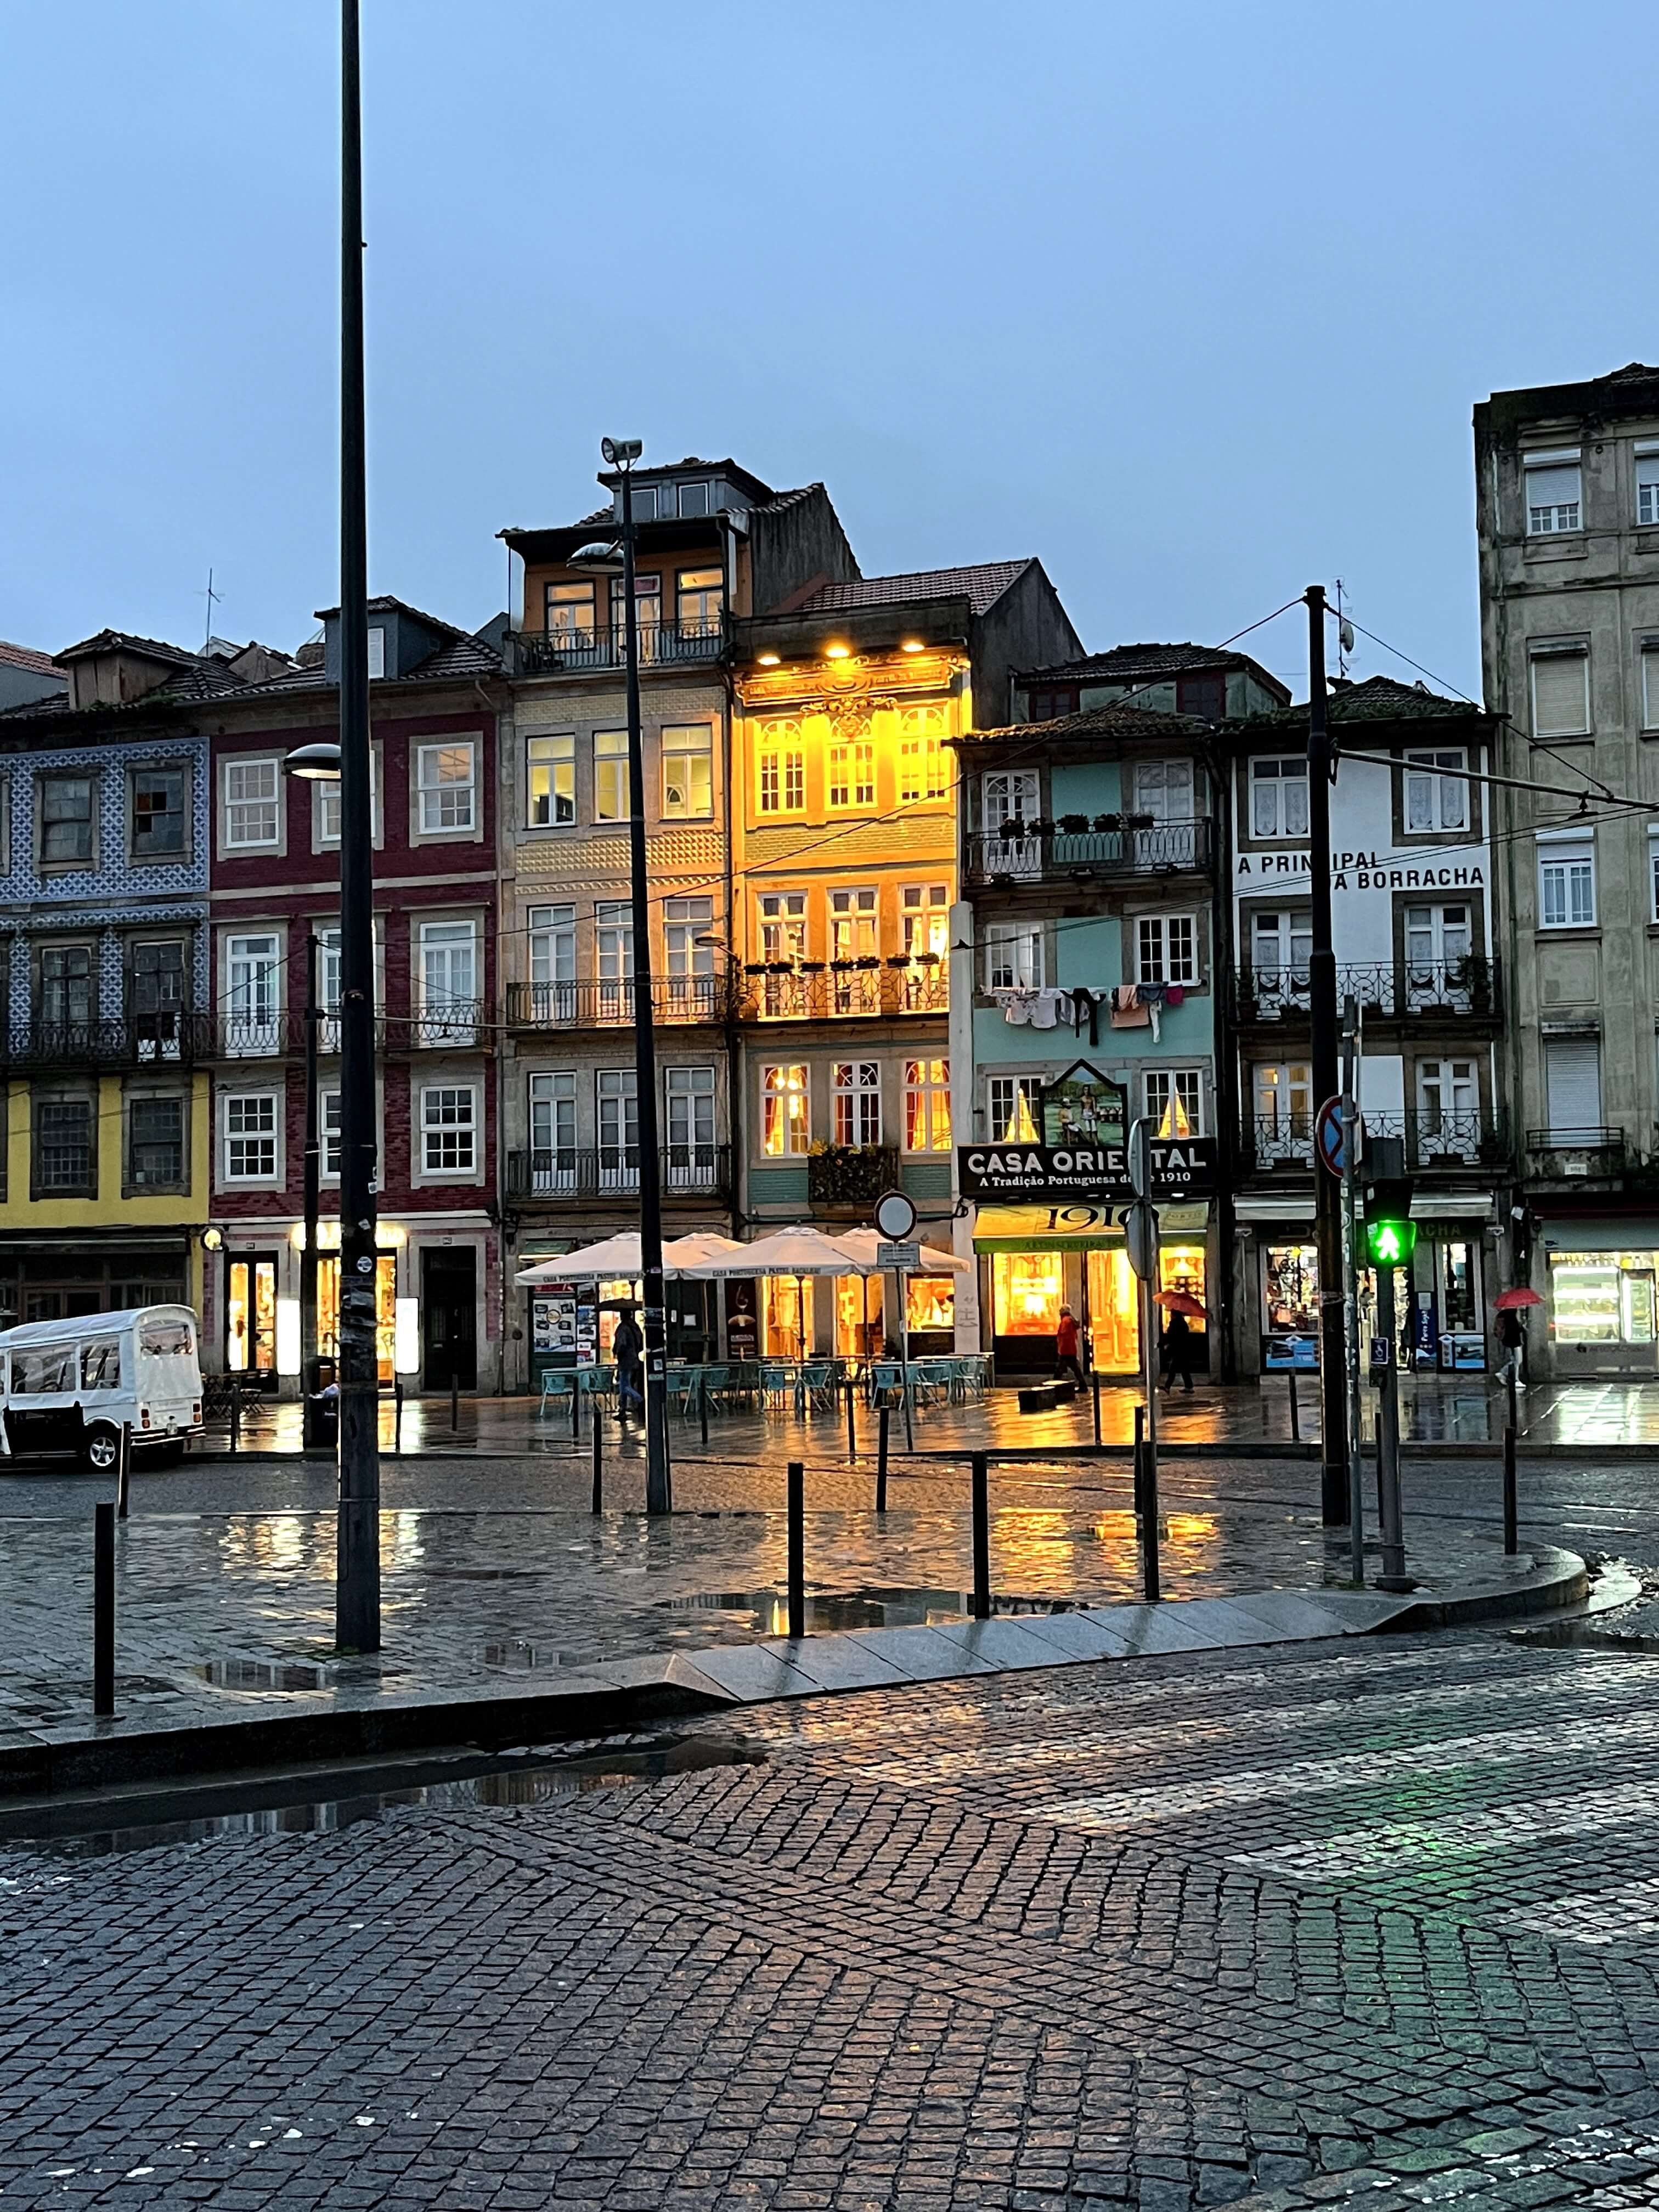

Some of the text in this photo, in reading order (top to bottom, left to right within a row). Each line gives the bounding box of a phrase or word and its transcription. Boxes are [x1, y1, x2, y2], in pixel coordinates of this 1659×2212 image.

[1238, 852, 1380, 874] A PRINIPAL
[1358, 867, 1483, 889] BORRACHA
[968, 1148, 1206, 1175] CASA ORIETAL
[979, 1177, 989, 1187] A
[991, 1176, 1045, 1188] Tradição
[1048, 1175, 1116, 1187] Portuguesa
[1160, 1171, 1191, 1182] 1910
